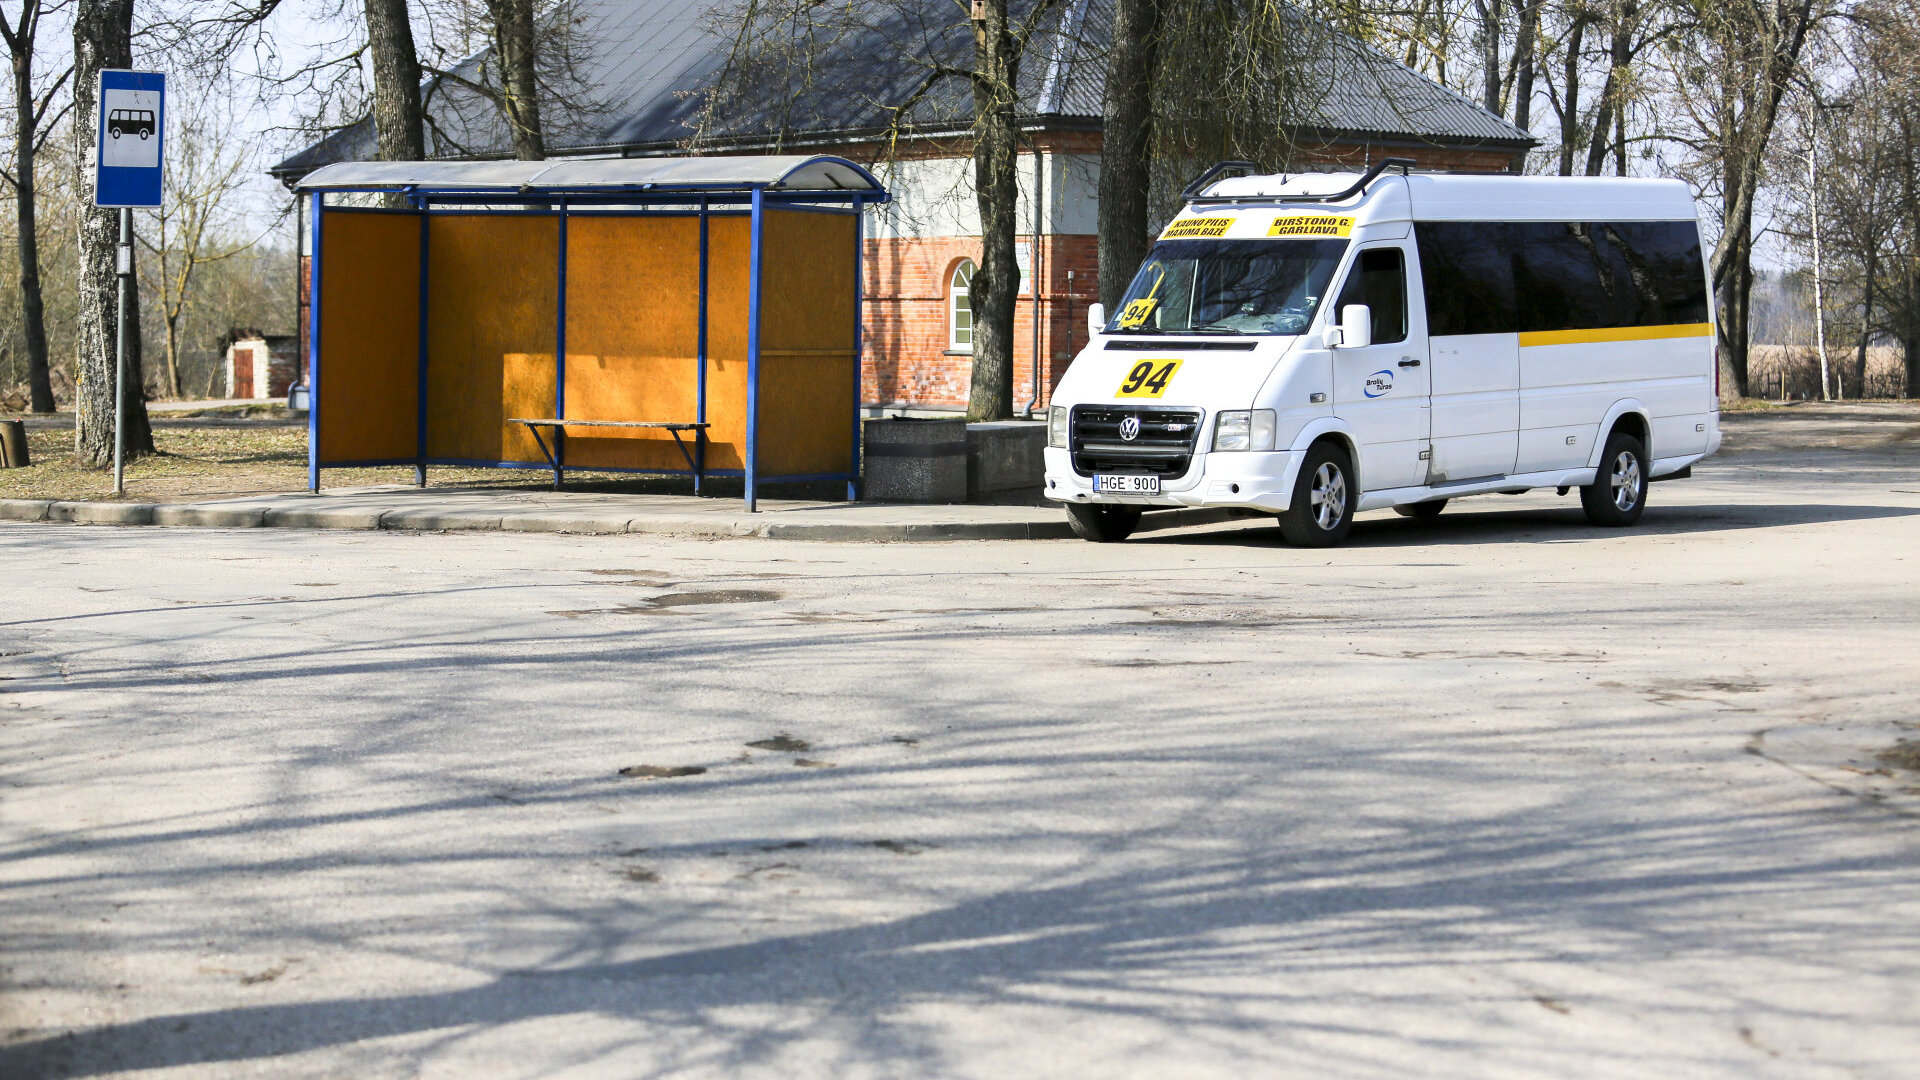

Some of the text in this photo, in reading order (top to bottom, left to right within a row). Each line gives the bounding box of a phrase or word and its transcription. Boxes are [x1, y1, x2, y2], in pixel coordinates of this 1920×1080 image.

[1174, 219, 1230, 228] KAUNO PILIS
[1273, 217, 1350, 227] BIRŠTONO G.
[1165, 228, 1200, 238] MAXIMA
[1278, 227, 1338, 235] GARLIAVA
[1125, 305, 1149, 321] 94
[1122, 362, 1176, 393] 94
[1100, 476, 1157, 490] HGE 900
